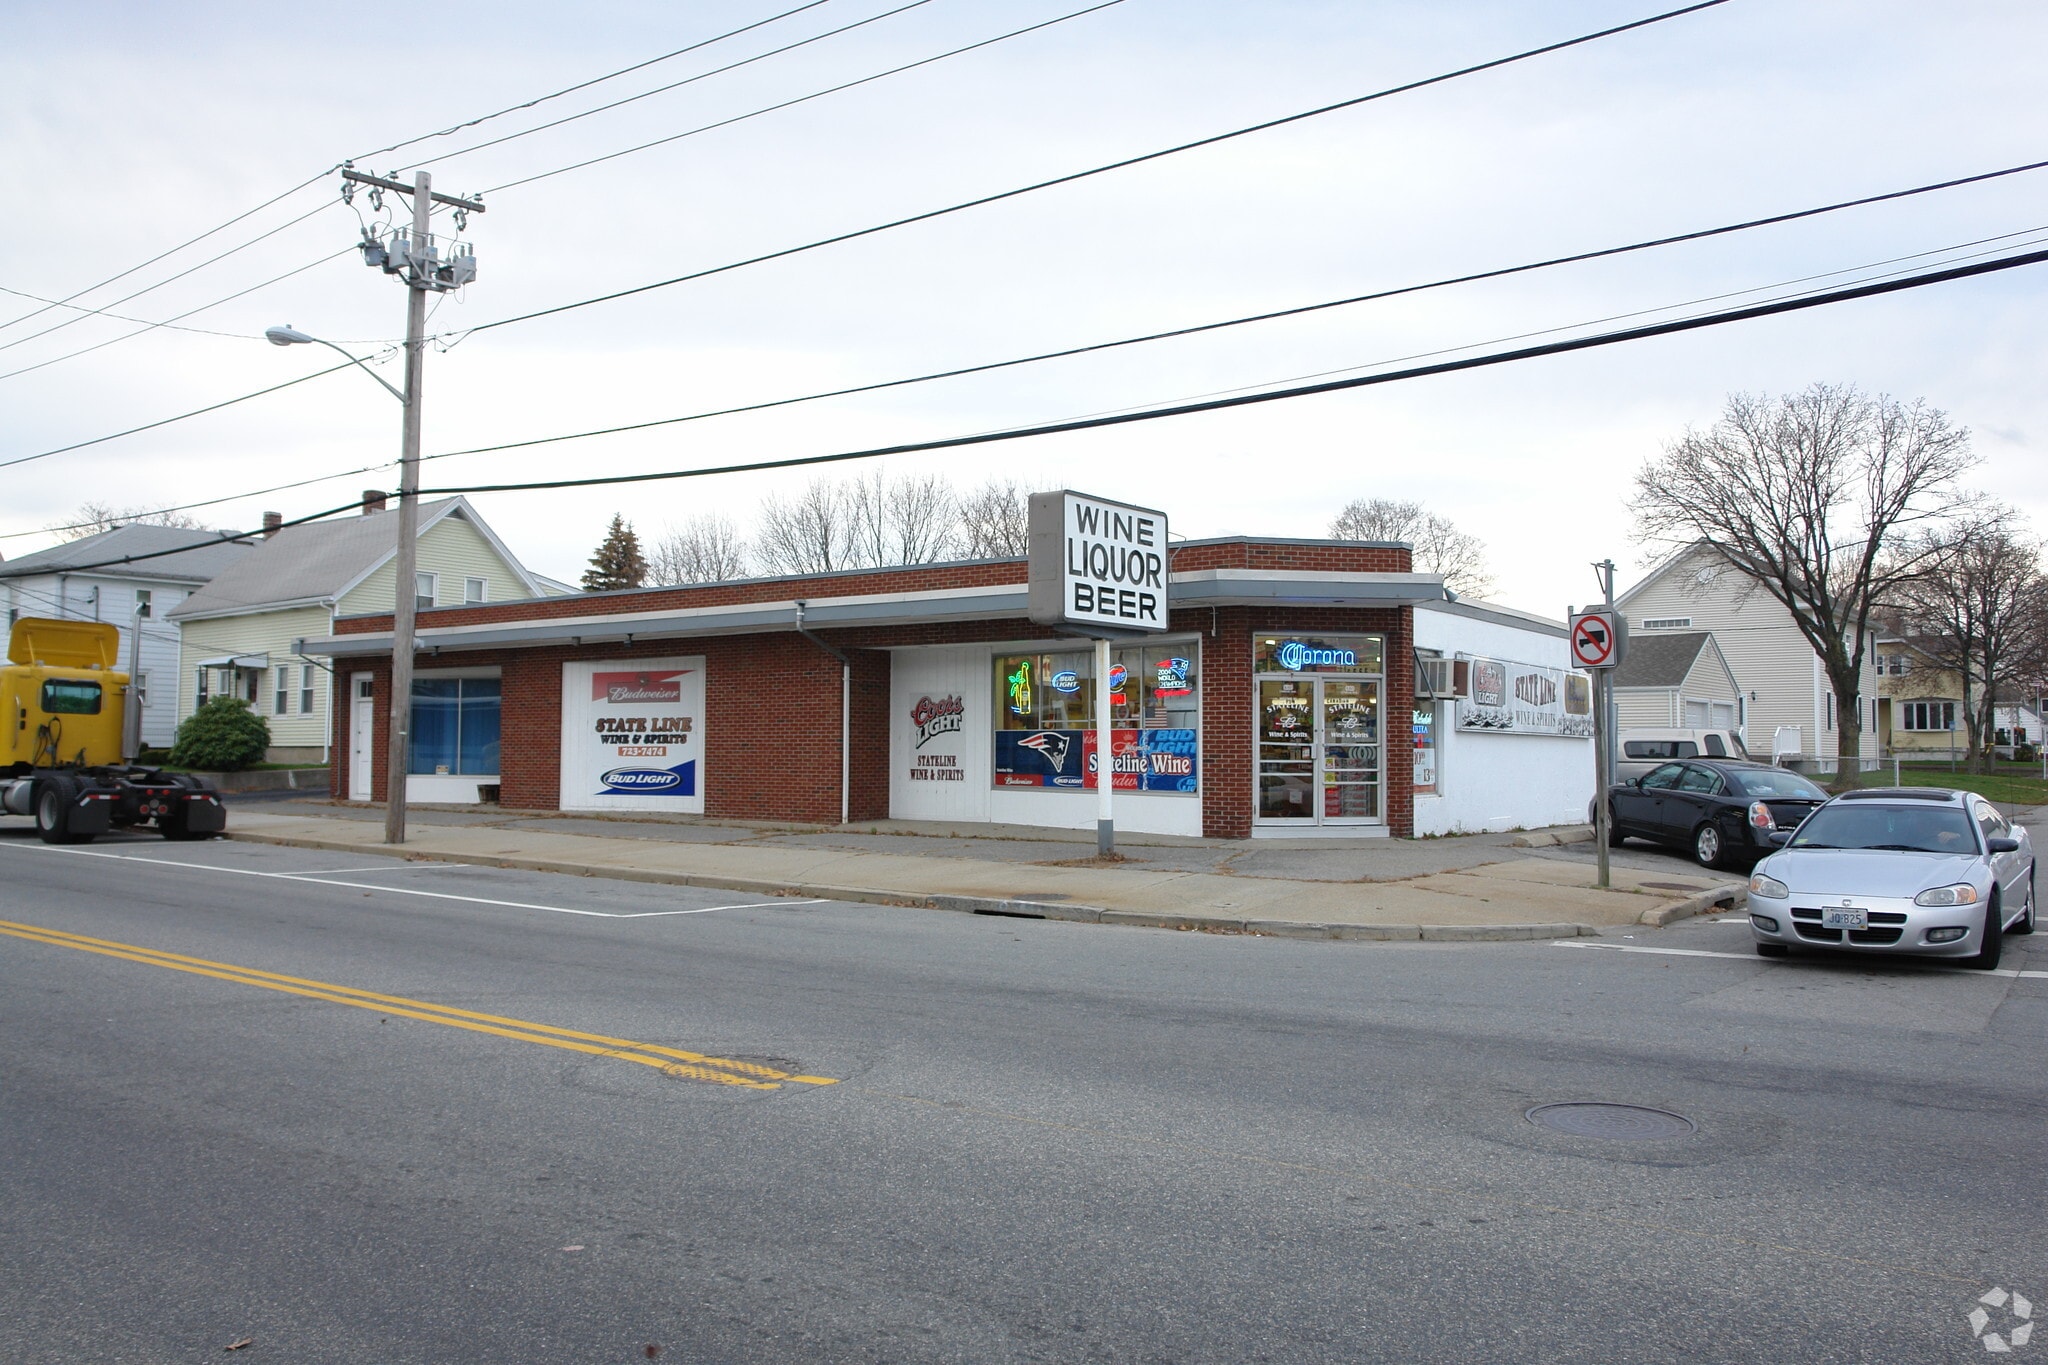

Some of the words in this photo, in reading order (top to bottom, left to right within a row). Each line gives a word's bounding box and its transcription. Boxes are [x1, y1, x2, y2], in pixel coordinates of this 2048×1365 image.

[1076, 503, 1154, 547] WINE
[1068, 537, 1162, 589] LIQUOR
[1075, 582, 1157, 621] BEER
[1281, 643, 1355, 671] Corona
[609, 687, 679, 701] Budweiser
[1515, 673, 1538, 707] STATE
[1539, 675, 1556, 706] LINE
[1478, 691, 1499, 705] LIGHT
[911, 694, 964, 728] Coors
[1266, 703, 1310, 714] STATELINE
[1328, 704, 1371, 715] STATELINE
[595, 718, 646, 733] STATE
[651, 716, 693, 733] LINE
[1516, 710, 1530, 725] WINE
[1537, 712, 1556, 727] SPIRITS
[916, 715, 962, 749] LIGHT
[1155, 730, 1195, 742] BUD
[1290, 731, 1308, 739] Spirits
[601, 734, 630, 745] WINE
[632, 734, 642, 745] &
[643, 734, 688, 745] SPIRITS
[621, 747, 663, 756] 723-7474
[1149, 741, 1196, 754] LIGHT
[917, 755, 957, 767] STATELINE
[1088, 753, 1149, 774] Steline
[1151, 753, 1191, 775] Wine
[607, 774, 635, 784] BUD
[636, 774, 675, 784] LIGHT
[910, 769, 928, 780] WINE
[930, 769, 935, 780] &
[937, 769, 964, 781] SPIRITS
[1004, 776, 1034, 785] Budweiser
